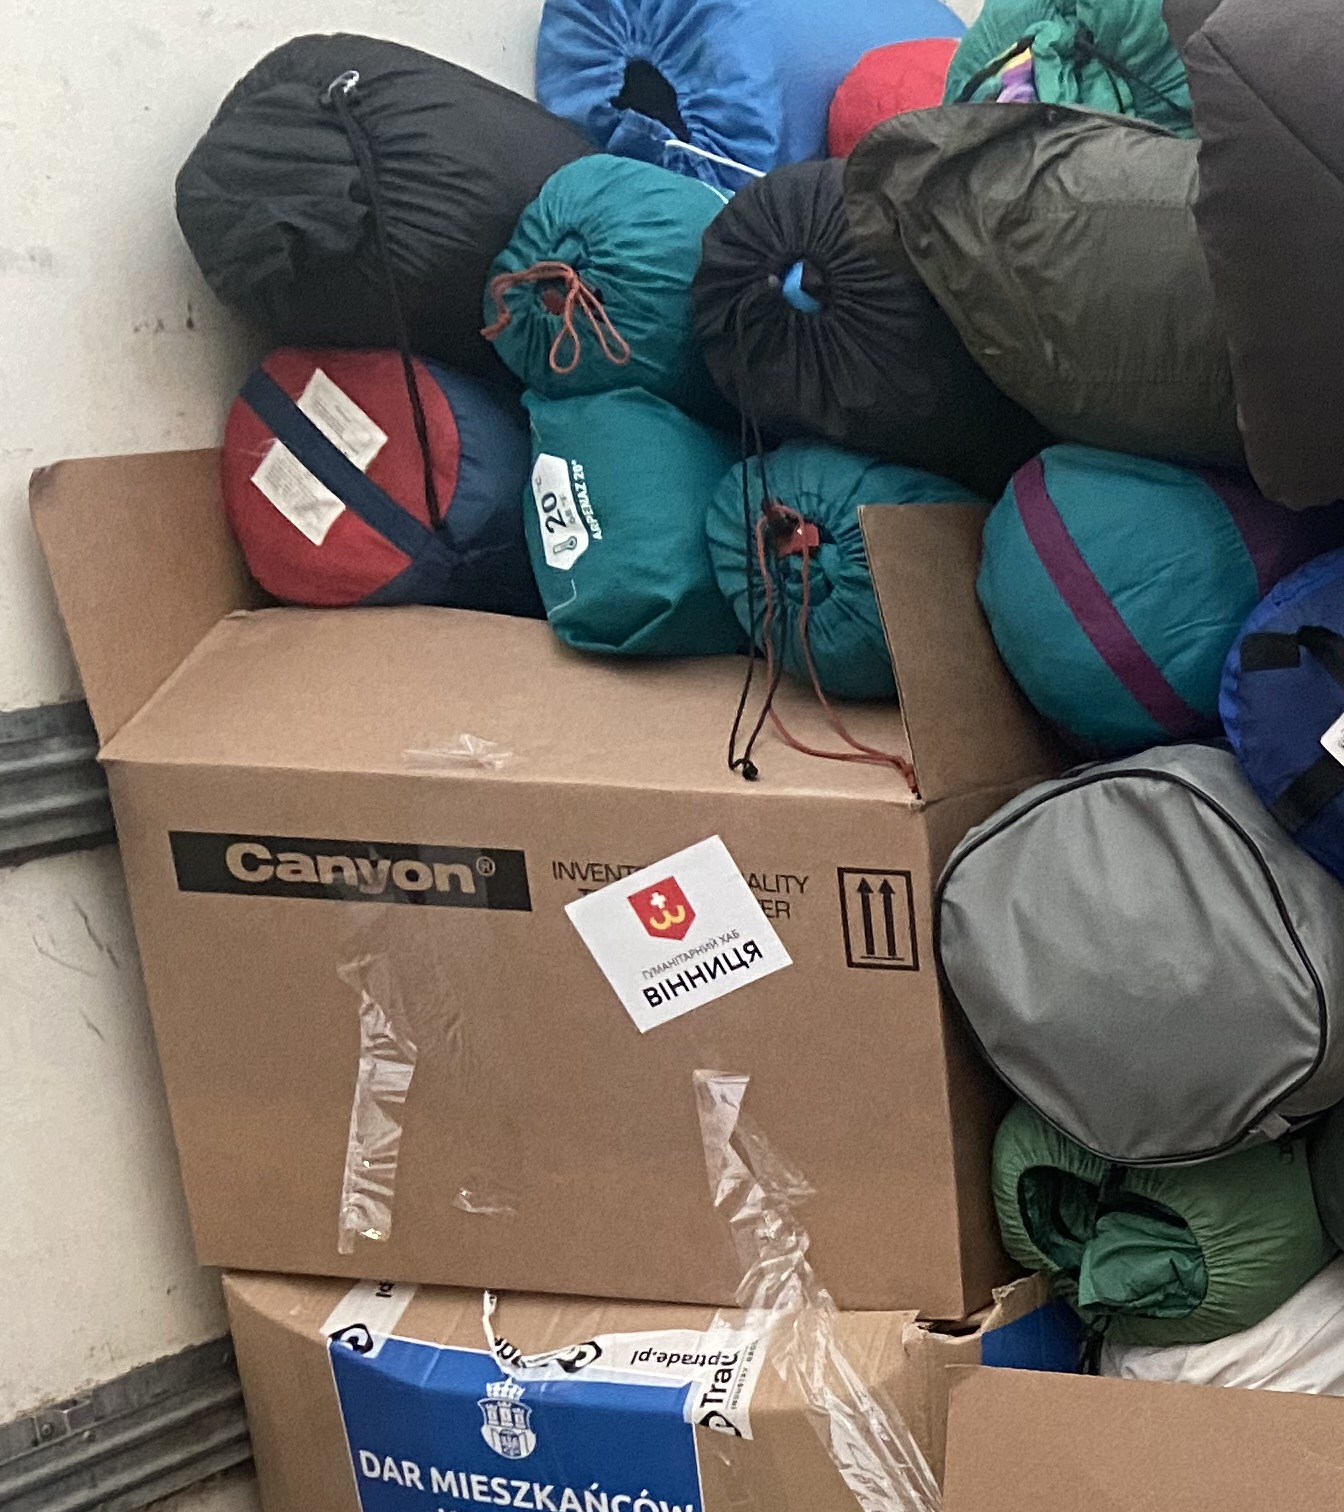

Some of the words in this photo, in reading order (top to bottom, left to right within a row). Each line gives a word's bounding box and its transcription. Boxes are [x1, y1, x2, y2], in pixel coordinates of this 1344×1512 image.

[541, 492, 567, 534] 20
[642, 935, 718, 981] ГУМАНІТАРНИЙ
[718, 929, 740, 946] ХАБ
[642, 940, 763, 1008] ВІННИЦЯ
[359, 1448, 425, 1491] DAR
